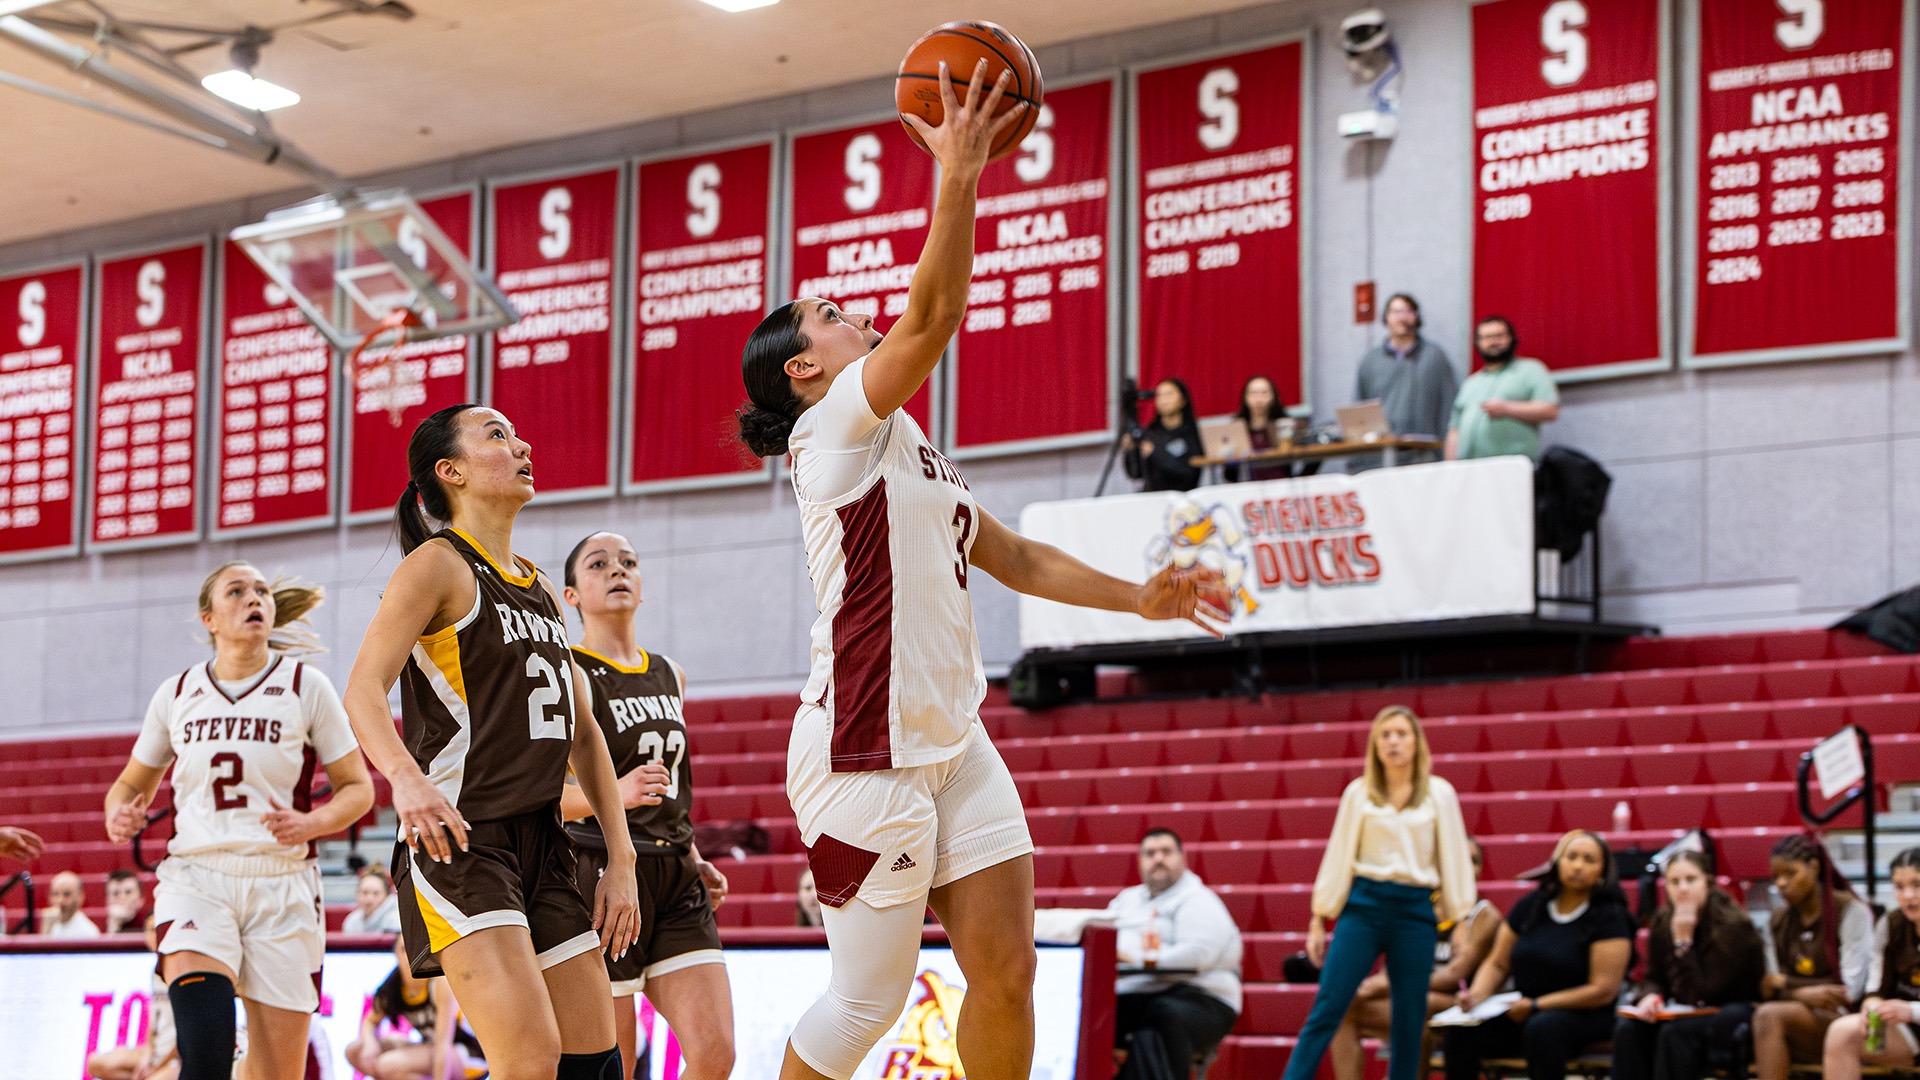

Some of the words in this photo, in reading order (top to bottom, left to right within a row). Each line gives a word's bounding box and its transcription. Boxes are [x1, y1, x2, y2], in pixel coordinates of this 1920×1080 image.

[1541, 0, 1587, 86] S
[1198, 67, 1239, 149] S
[1751, 83, 1843, 126] NCAA
[1482, 108, 1649, 161] CONFERENCE
[1708, 112, 1889, 159] APPEARANCES
[845, 134, 881, 211] S
[1481, 137, 1649, 191] CHAMPIONS
[1710, 161, 1760, 190] 2013
[1771, 154, 1822, 183] 2014
[1833, 147, 1884, 176] 2015
[687, 163, 721, 238] S
[1145, 170, 1292, 220] CONFERENCE
[1484, 193, 1531, 223] 2019
[1708, 192, 1760, 221] 2016
[1771, 185, 1821, 214] 2017
[1832, 178, 1884, 208] 2018
[539, 187, 572, 258] S
[997, 211, 1067, 248] NCAA
[1145, 199, 1292, 249] CHAMPIONS
[1707, 224, 1760, 252] 2019
[1767, 216, 1822, 246] 2022
[1830, 210, 1885, 240] 2023
[641, 258, 763, 299] CONFERENCE
[828, 238, 894, 275] NCAA
[1706, 255, 1762, 285] 2024
[18, 281, 45, 346] S
[136, 260, 165, 326] S
[506, 281, 609, 317] ONFERENCE
[641, 284, 762, 325] CHAMPIONS
[1243, 491, 1365, 534] STEVENS
[951, 501, 972, 591] 3
[1253, 533, 1381, 592] DUCKS
[526, 652, 576, 741] 21
[608, 695, 687, 734] ROWAN
[183, 716, 282, 744] STEVENS
[210, 752, 247, 811] 2
[890, 861, 916, 872] adidas
